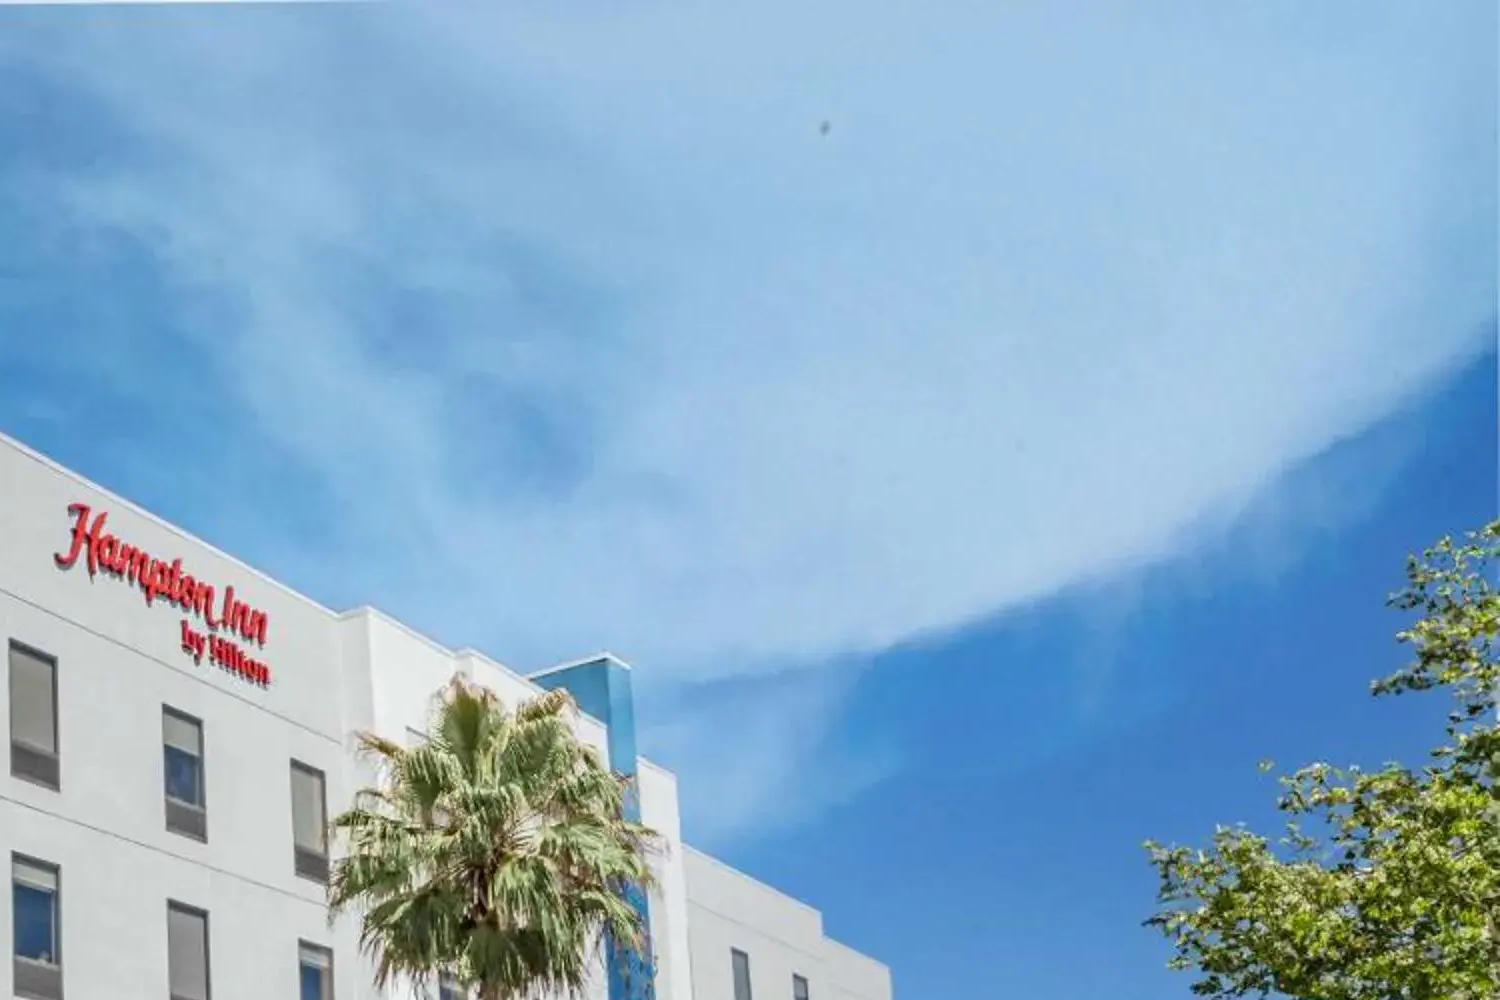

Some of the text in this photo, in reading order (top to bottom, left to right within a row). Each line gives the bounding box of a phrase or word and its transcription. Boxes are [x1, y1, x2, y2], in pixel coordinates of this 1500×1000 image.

[54, 502, 268, 646] Hampton Inn
[181, 618, 271, 689] by Hilton
